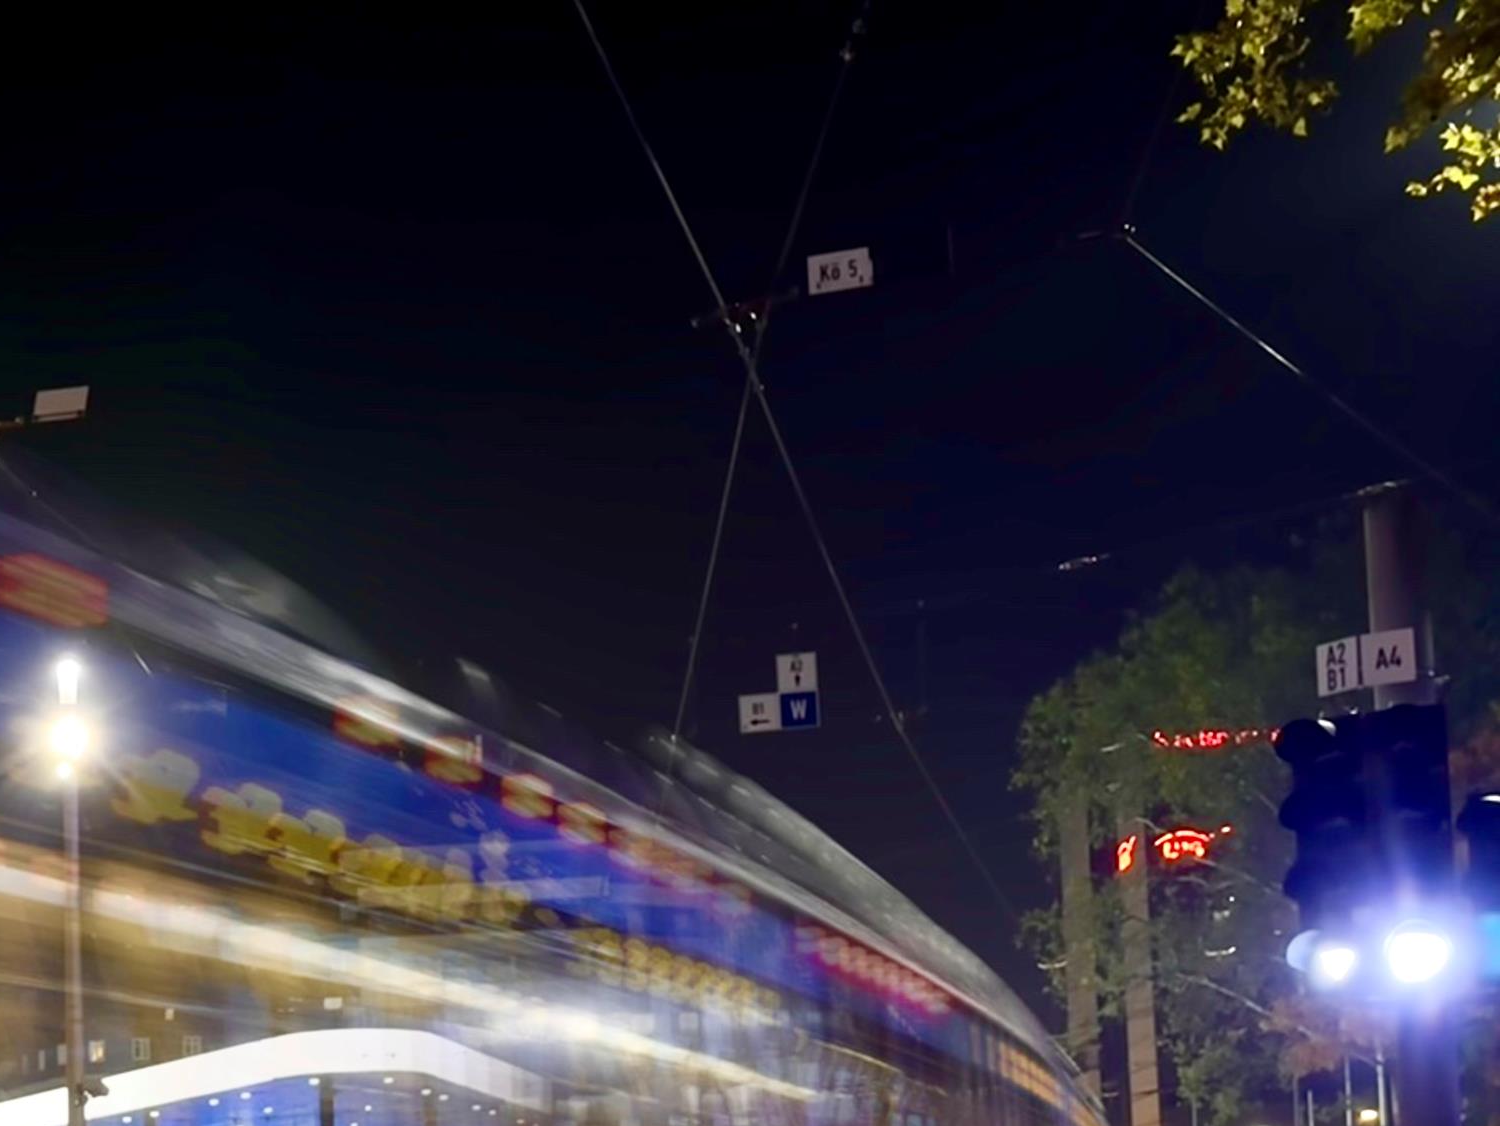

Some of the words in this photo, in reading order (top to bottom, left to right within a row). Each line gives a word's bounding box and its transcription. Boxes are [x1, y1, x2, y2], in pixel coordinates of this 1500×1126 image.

[1327, 642, 1346, 667] A2
[1376, 645, 1401, 669] A4
[1327, 667, 1346, 691] B1
[790, 699, 807, 720] W
